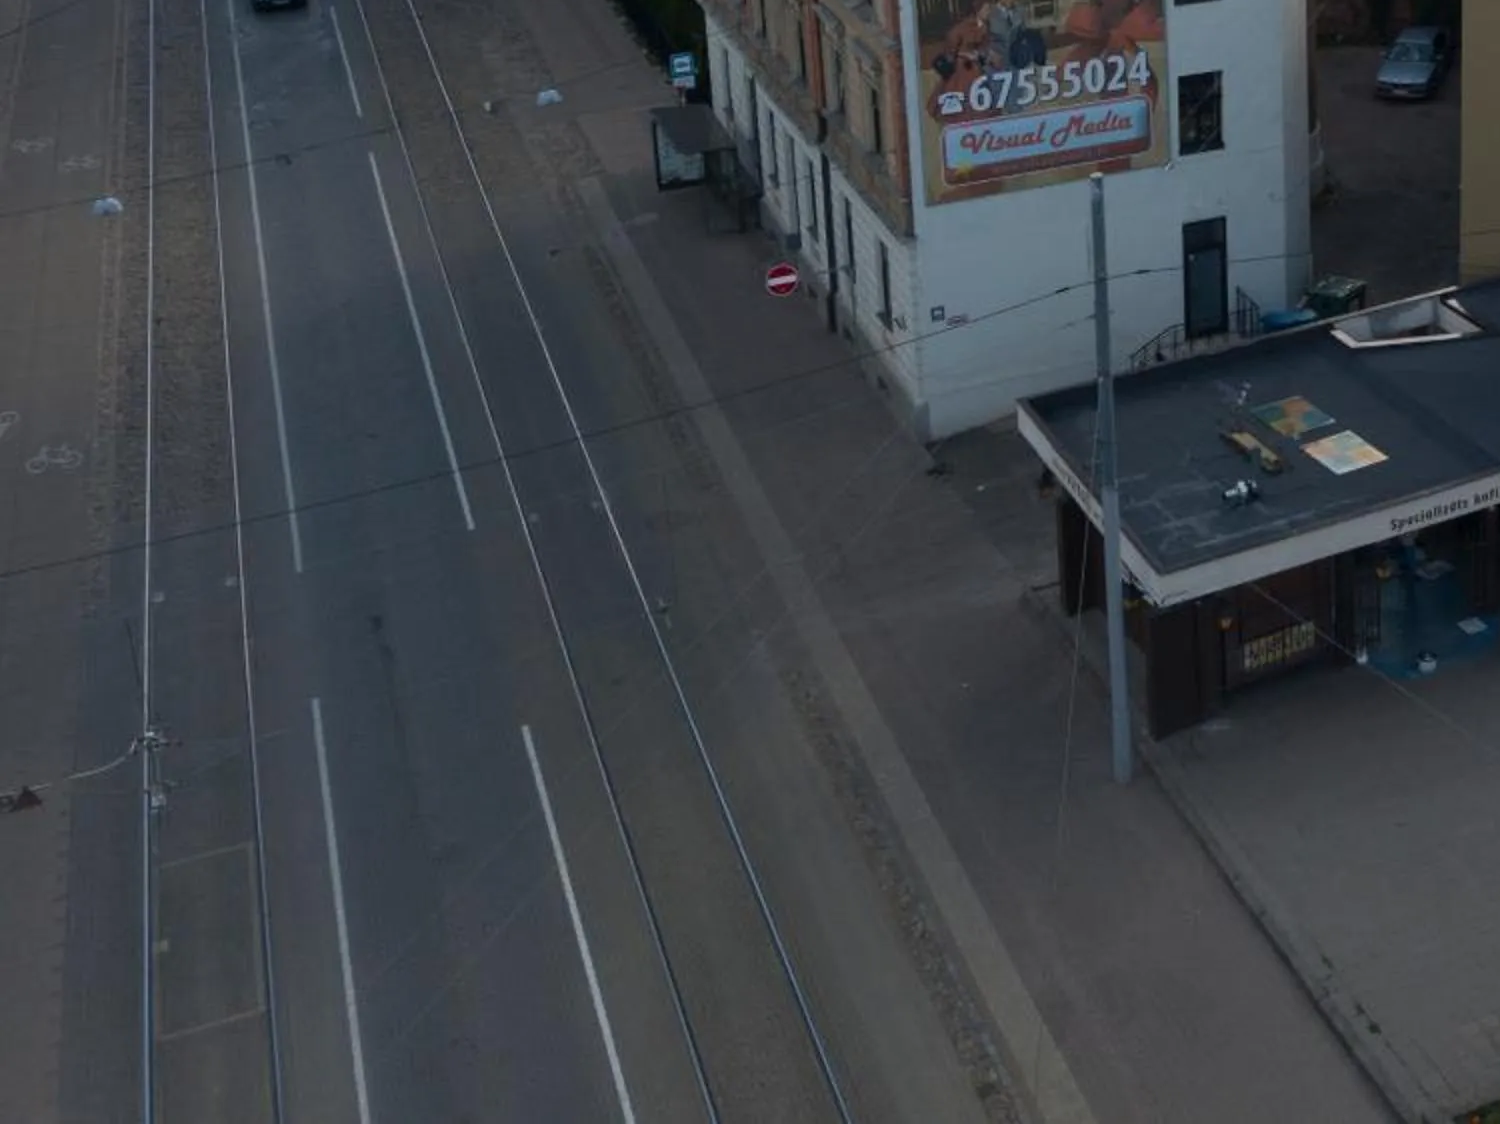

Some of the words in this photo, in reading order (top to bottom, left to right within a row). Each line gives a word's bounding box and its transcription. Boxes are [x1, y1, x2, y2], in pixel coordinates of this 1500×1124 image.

[970, 51, 1150, 112] 67555024
[960, 120, 1045, 154] Visual
[1050, 112, 1134, 148] Media
